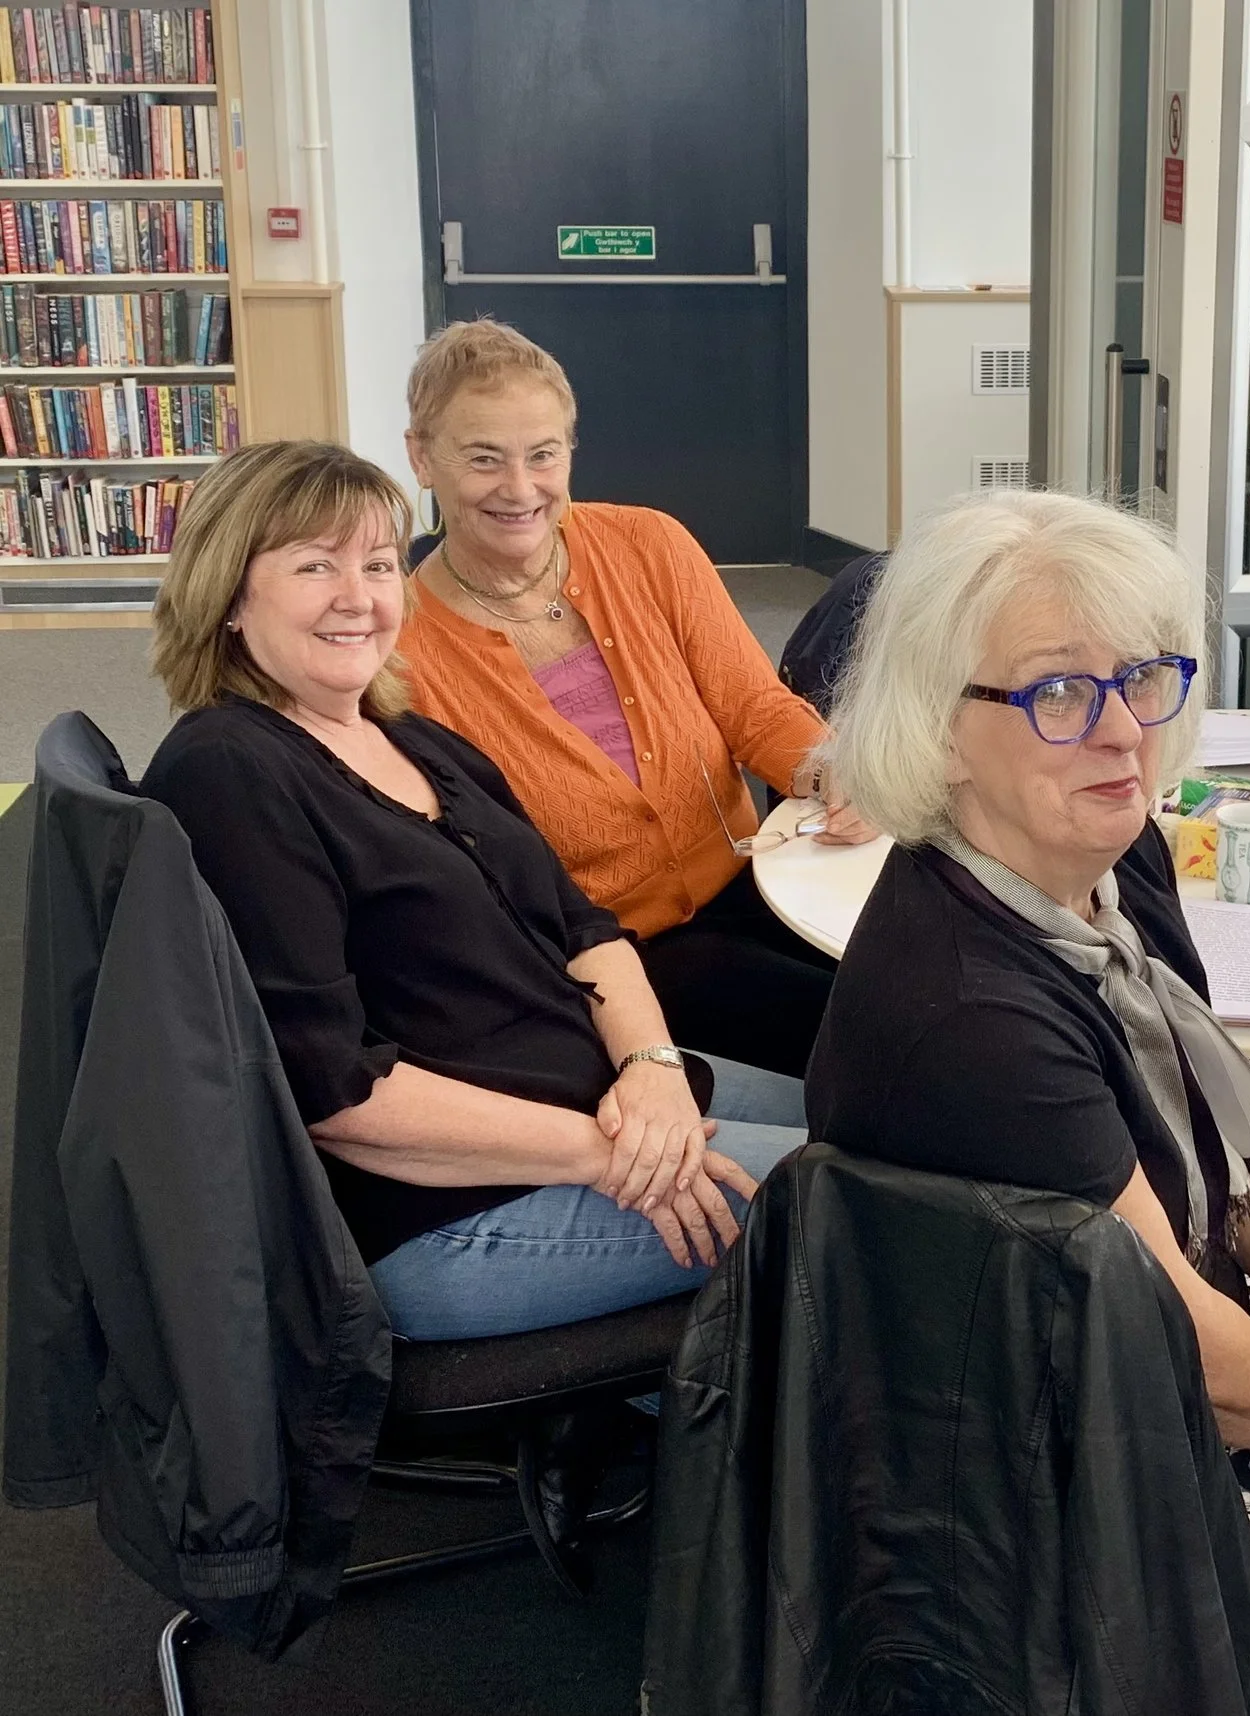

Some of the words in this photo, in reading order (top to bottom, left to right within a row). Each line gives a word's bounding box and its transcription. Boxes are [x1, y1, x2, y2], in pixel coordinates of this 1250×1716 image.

[583, 229, 602, 237] Push
[631, 231, 651, 239] open
[50, 299, 58, 326] NESS
